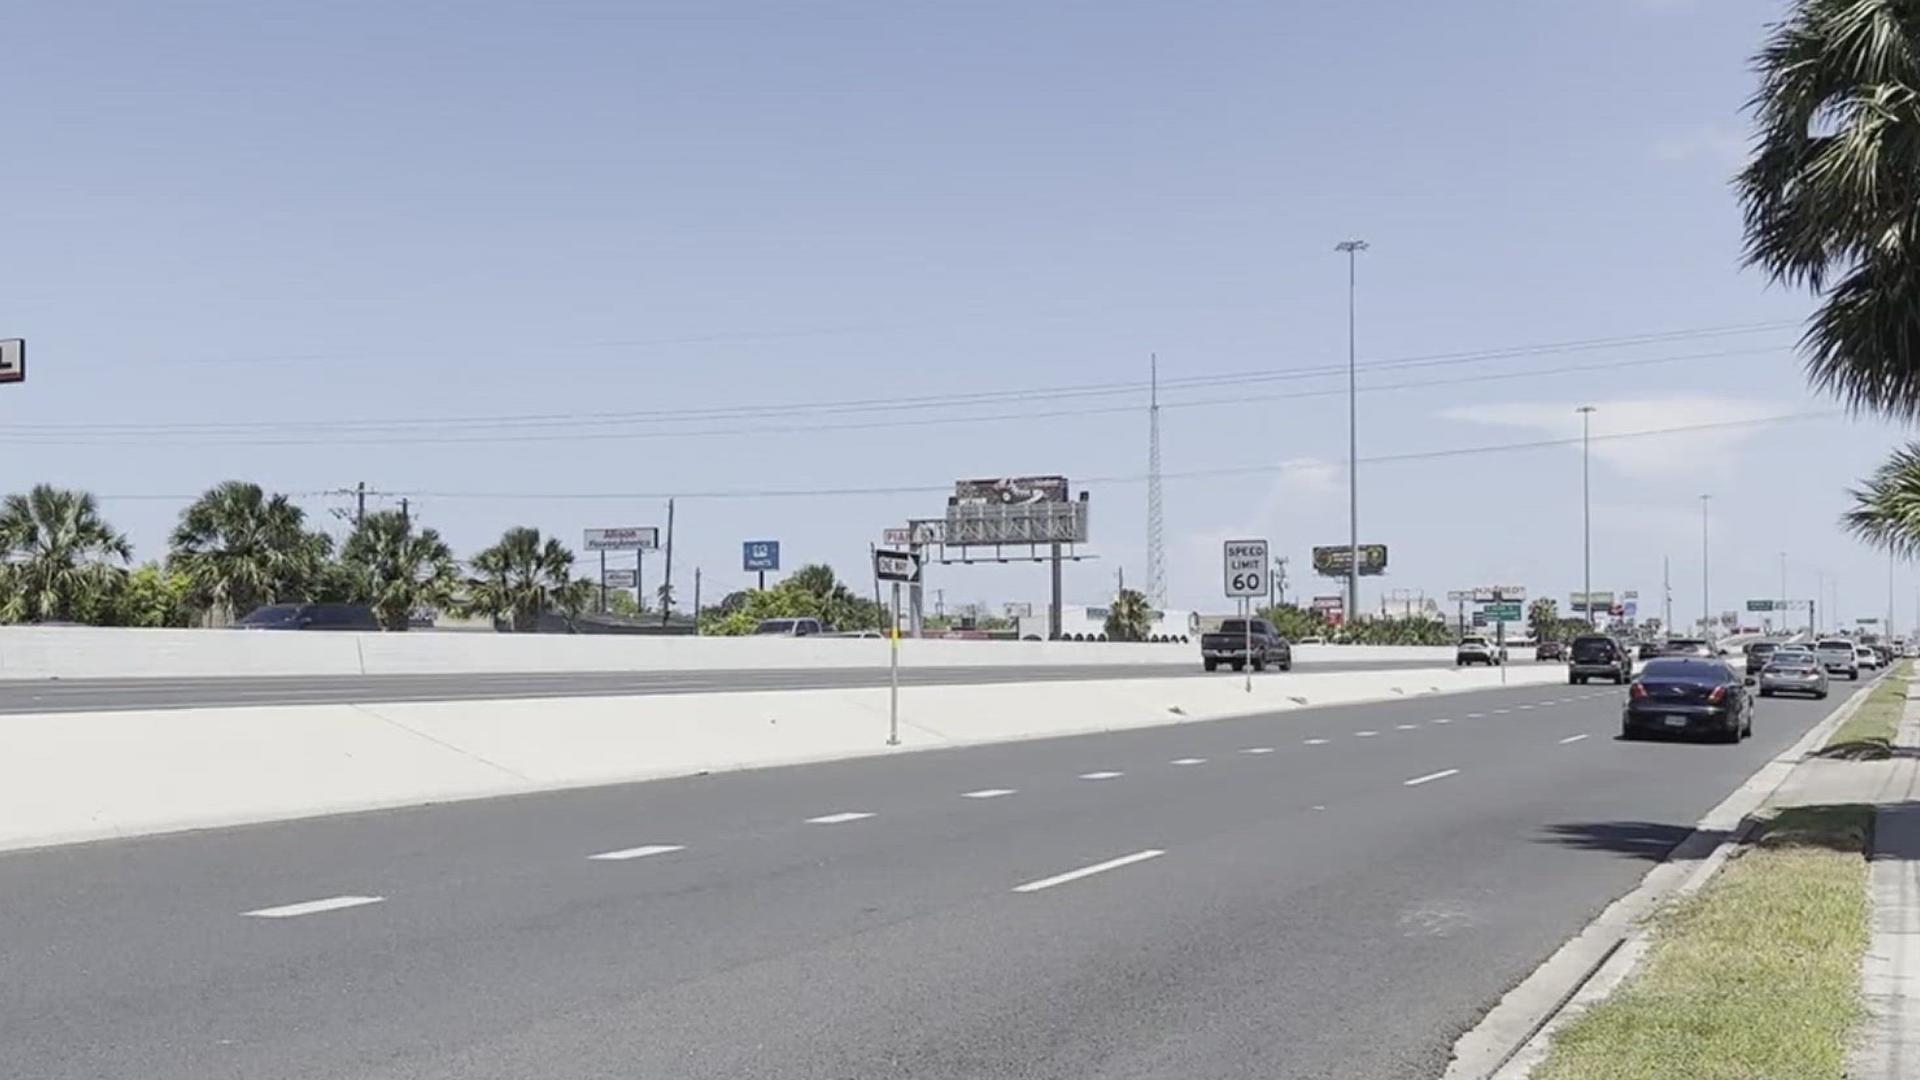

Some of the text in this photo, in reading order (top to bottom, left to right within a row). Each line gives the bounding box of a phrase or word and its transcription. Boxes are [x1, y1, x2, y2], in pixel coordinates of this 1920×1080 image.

[1228, 546, 1264, 557] SPEED
[879, 557, 907, 572] ONE WAY
[1231, 560, 1259, 570] LIMIT
[1232, 573, 1260, 591] 60
